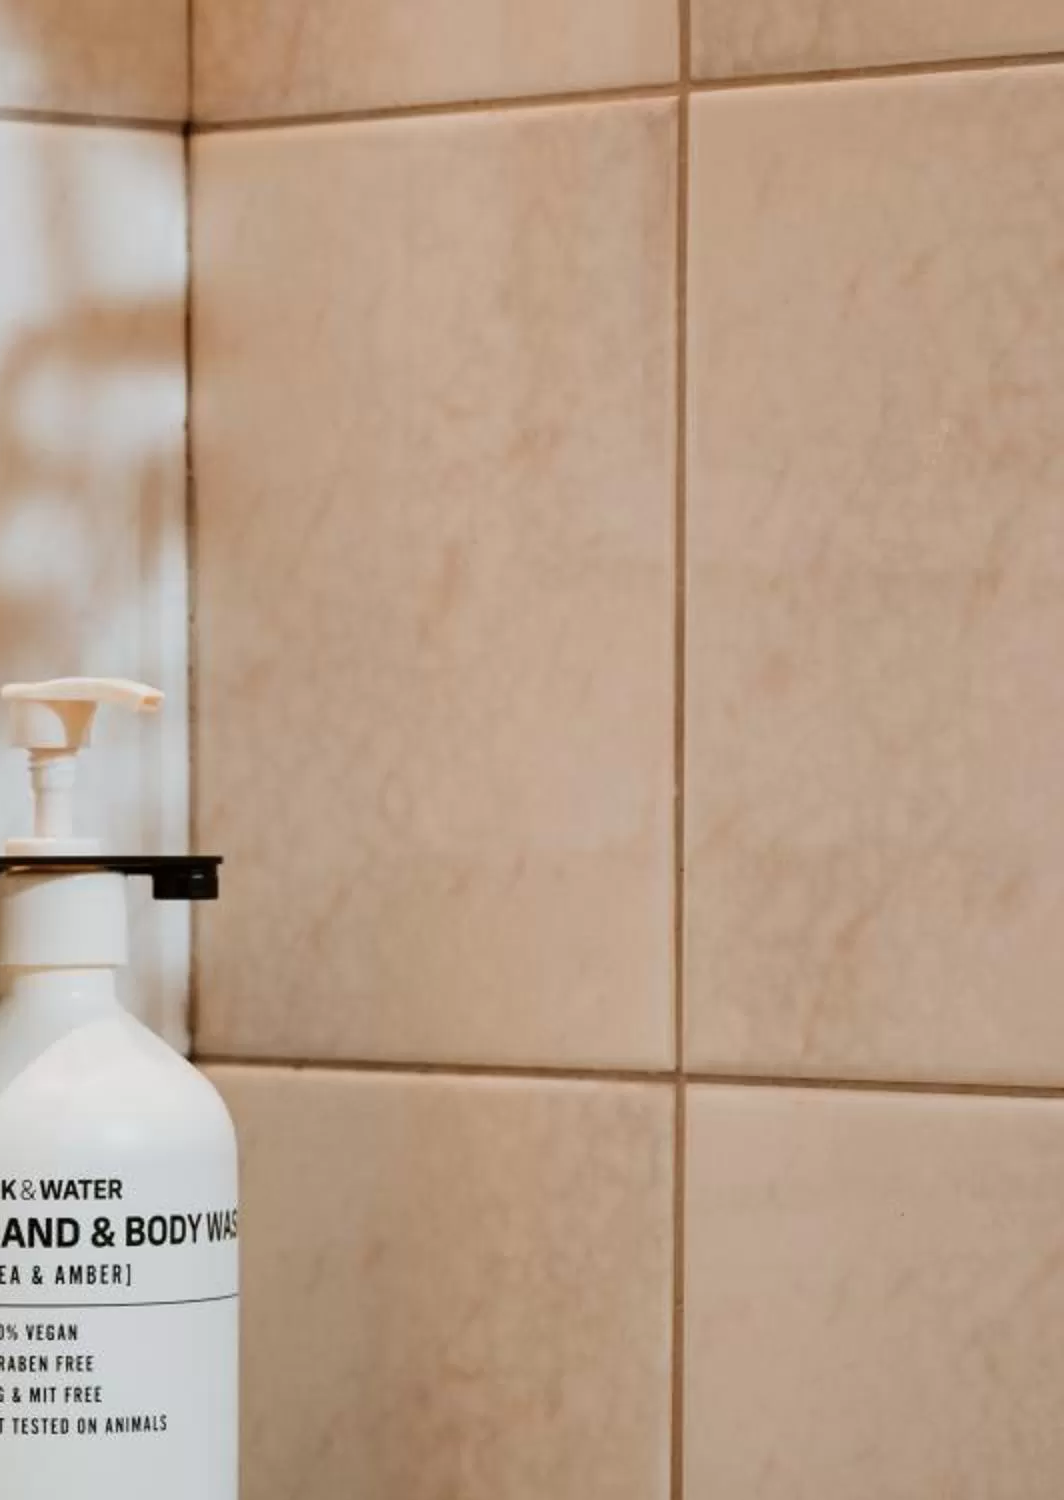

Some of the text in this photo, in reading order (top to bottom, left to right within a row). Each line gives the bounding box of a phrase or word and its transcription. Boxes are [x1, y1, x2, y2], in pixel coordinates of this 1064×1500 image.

[91, 1217, 115, 1248] &
[125, 1213, 202, 1247] BODY
[32, 1265, 43, 1285] &
[55, 1264, 131, 1286] AMBER]
[26, 1324, 78, 1341] VEGAN
[56, 1355, 94, 1372] FREE
[12, 1387, 21, 1403] &
[29, 1387, 56, 1403] MIT
[64, 1386, 102, 1403] FREE
[12, 1418, 69, 1435] TESTED
[77, 1417, 97, 1434] ON
[105, 1414, 167, 1434] ANIMALS
